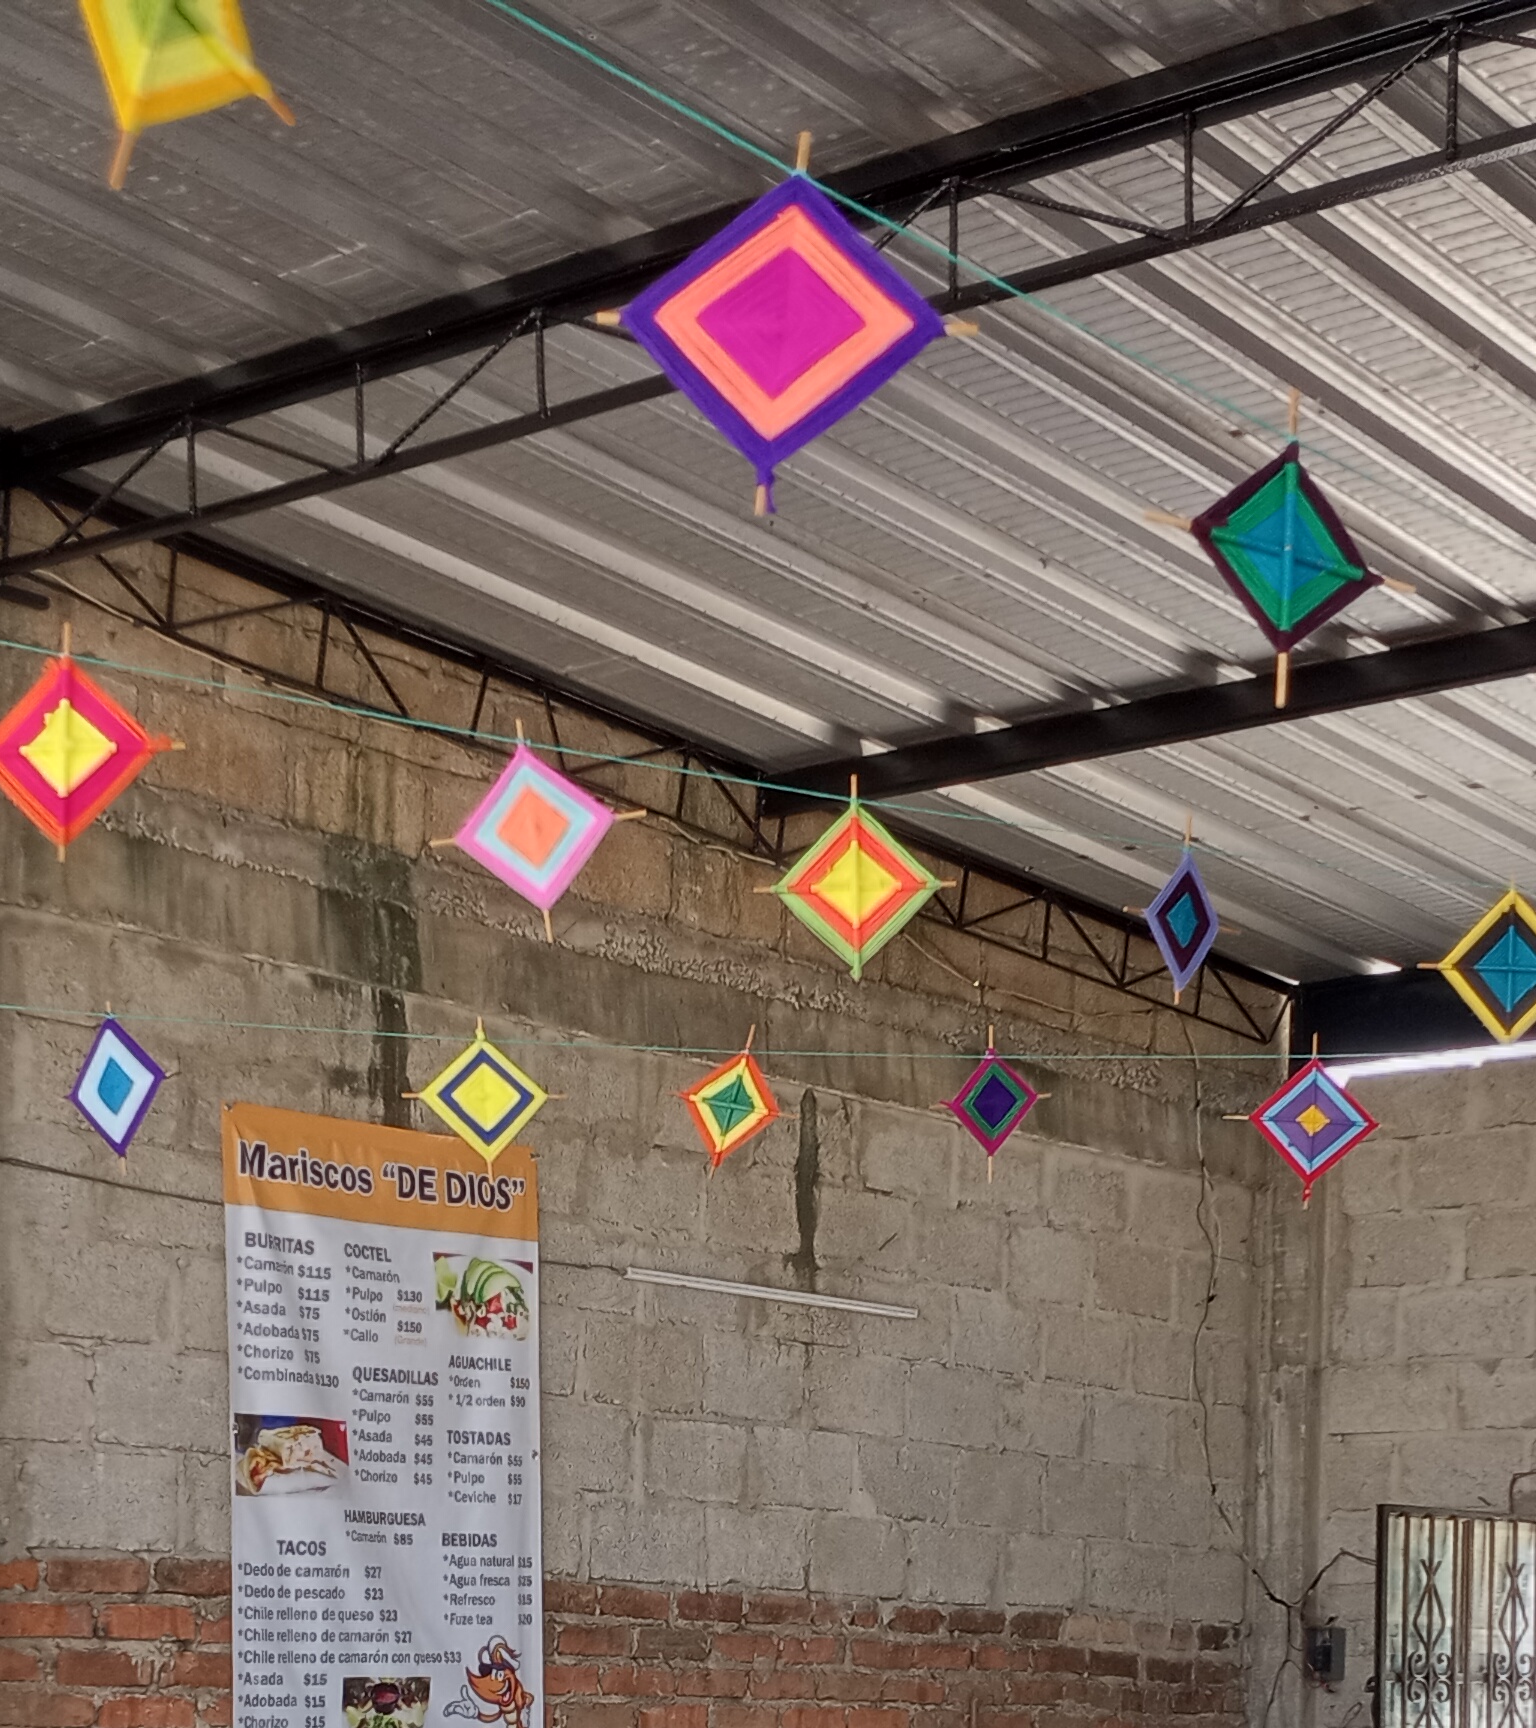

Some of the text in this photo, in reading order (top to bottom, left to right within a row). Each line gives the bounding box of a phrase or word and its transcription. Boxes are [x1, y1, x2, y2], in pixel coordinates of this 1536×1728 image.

[238, 1141, 373, 1193] Mariscos
[245, 1232, 315, 1255] BURRITAS
[344, 1243, 392, 1263] COCTEL
[297, 1265, 331, 1280] $115
[298, 1287, 330, 1302] $115
[397, 1290, 423, 1303] $130
[299, 1306, 320, 1320] $75
[397, 1321, 422, 1333] $150
[448, 1355, 512, 1372] AGUACHILE
[352, 1366, 439, 1386] QUESADILLAS
[510, 1377, 530, 1390] $150
[475, 1394, 505, 1408] orden
[415, 1414, 434, 1426] $55
[415, 1434, 433, 1446] $45
[447, 1430, 511, 1445] TOSTADAS
[414, 1453, 433, 1465] $45
[414, 1473, 432, 1485] $45
[344, 1510, 426, 1527] HAMBURGUESA
[393, 1533, 413, 1546] $85
[442, 1532, 498, 1547] BEBIDAS
[276, 1540, 327, 1556] TACOS
[480, 1555, 514, 1567] natural
[277, 1564, 291, 1577] de
[295, 1564, 350, 1578] camarón
[365, 1565, 382, 1579] $27
[480, 1574, 510, 1586] fresca
[278, 1585, 291, 1598] de
[295, 1586, 345, 1601] pescado
[364, 1588, 384, 1601] $23
[277, 1607, 317, 1621] relleno
[322, 1608, 335, 1621] de
[338, 1609, 374, 1624] queso
[379, 1609, 398, 1622] $23
[476, 1614, 493, 1625] tea
[277, 1628, 317, 1643] relleno
[321, 1629, 335, 1643] de
[338, 1629, 389, 1643] camarón
[395, 1631, 412, 1643] $27
[278, 1651, 316, 1664] relleno
[320, 1651, 335, 1664] de
[338, 1650, 388, 1664] camarón
[392, 1652, 410, 1664] con
[444, 1651, 461, 1664] $33
[303, 1673, 327, 1686] $15
[304, 1696, 325, 1708] $15
